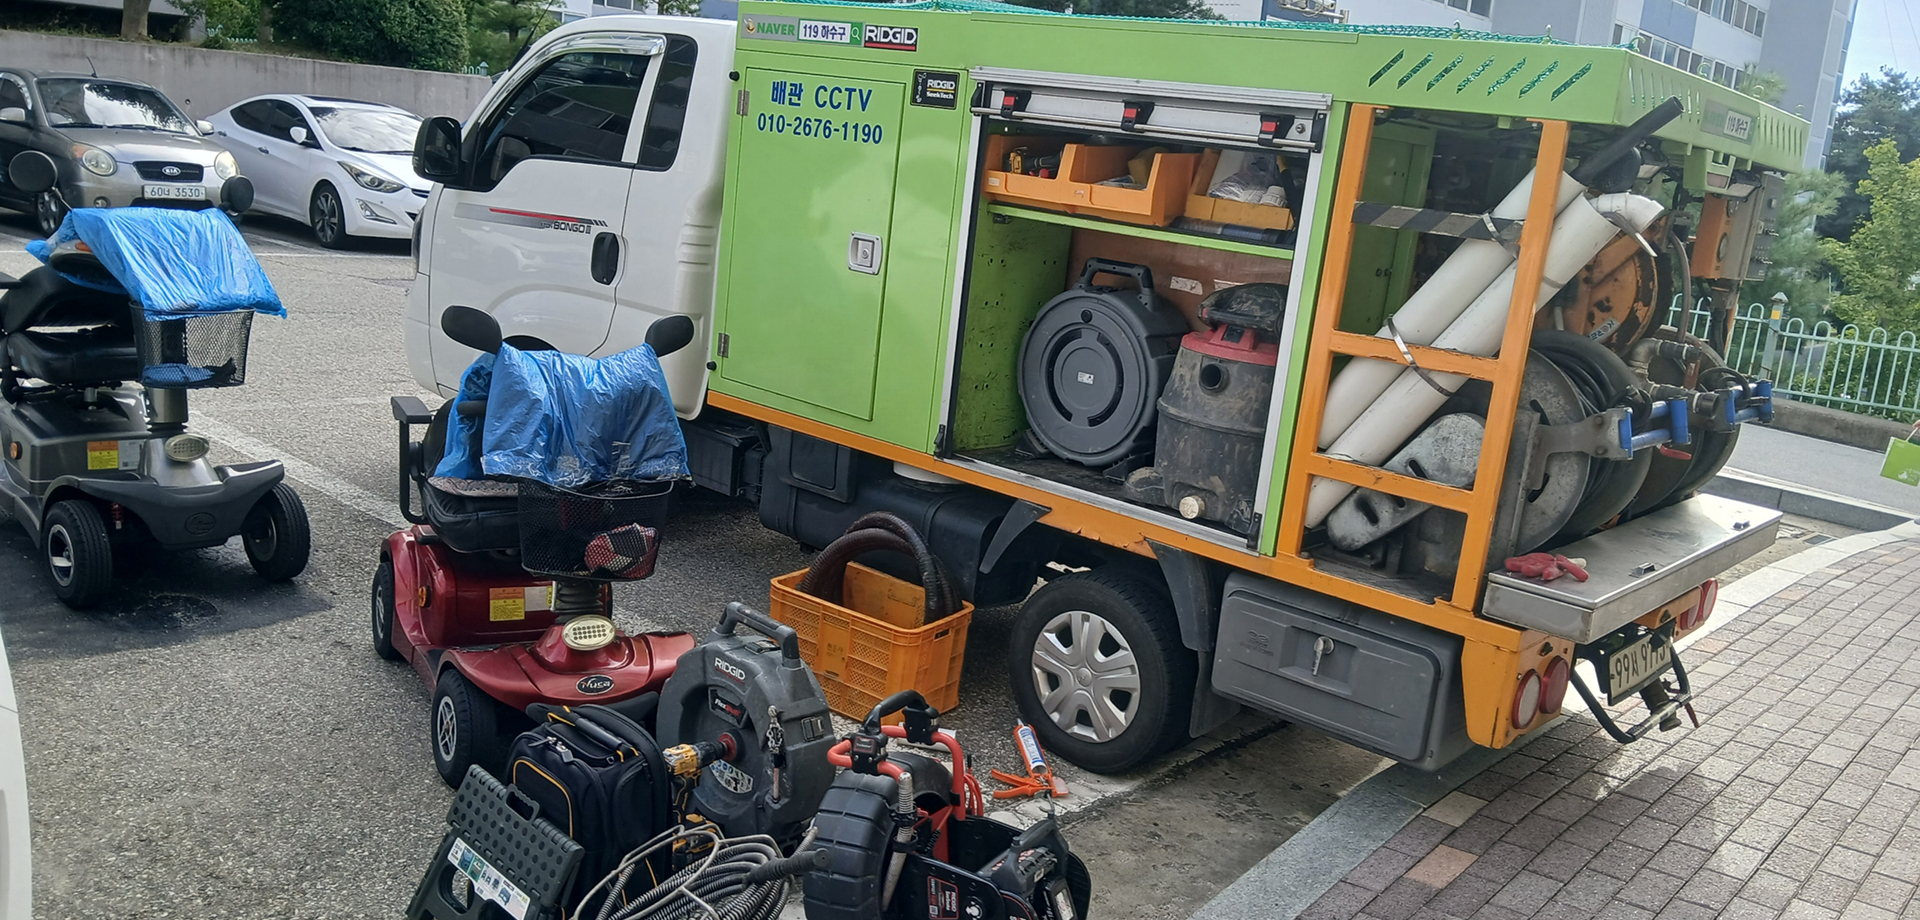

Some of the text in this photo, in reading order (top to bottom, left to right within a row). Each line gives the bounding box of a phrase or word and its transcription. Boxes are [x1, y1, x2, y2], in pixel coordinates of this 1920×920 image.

[756, 22, 796, 36] NAVER
[802, 24, 846, 41] 119 하수구
[865, 26, 918, 45] RIDGID
[926, 79, 956, 90] RIDGID
[771, 80, 873, 112] 배관 CCTV
[926, 91, 955, 100] SeekTech
[757, 113, 883, 145] 010-2676-1190
[150, 186, 200, 198] 60너 3530
[553, 221, 585, 233] BONGO
[714, 656, 746, 681] RIDGID
